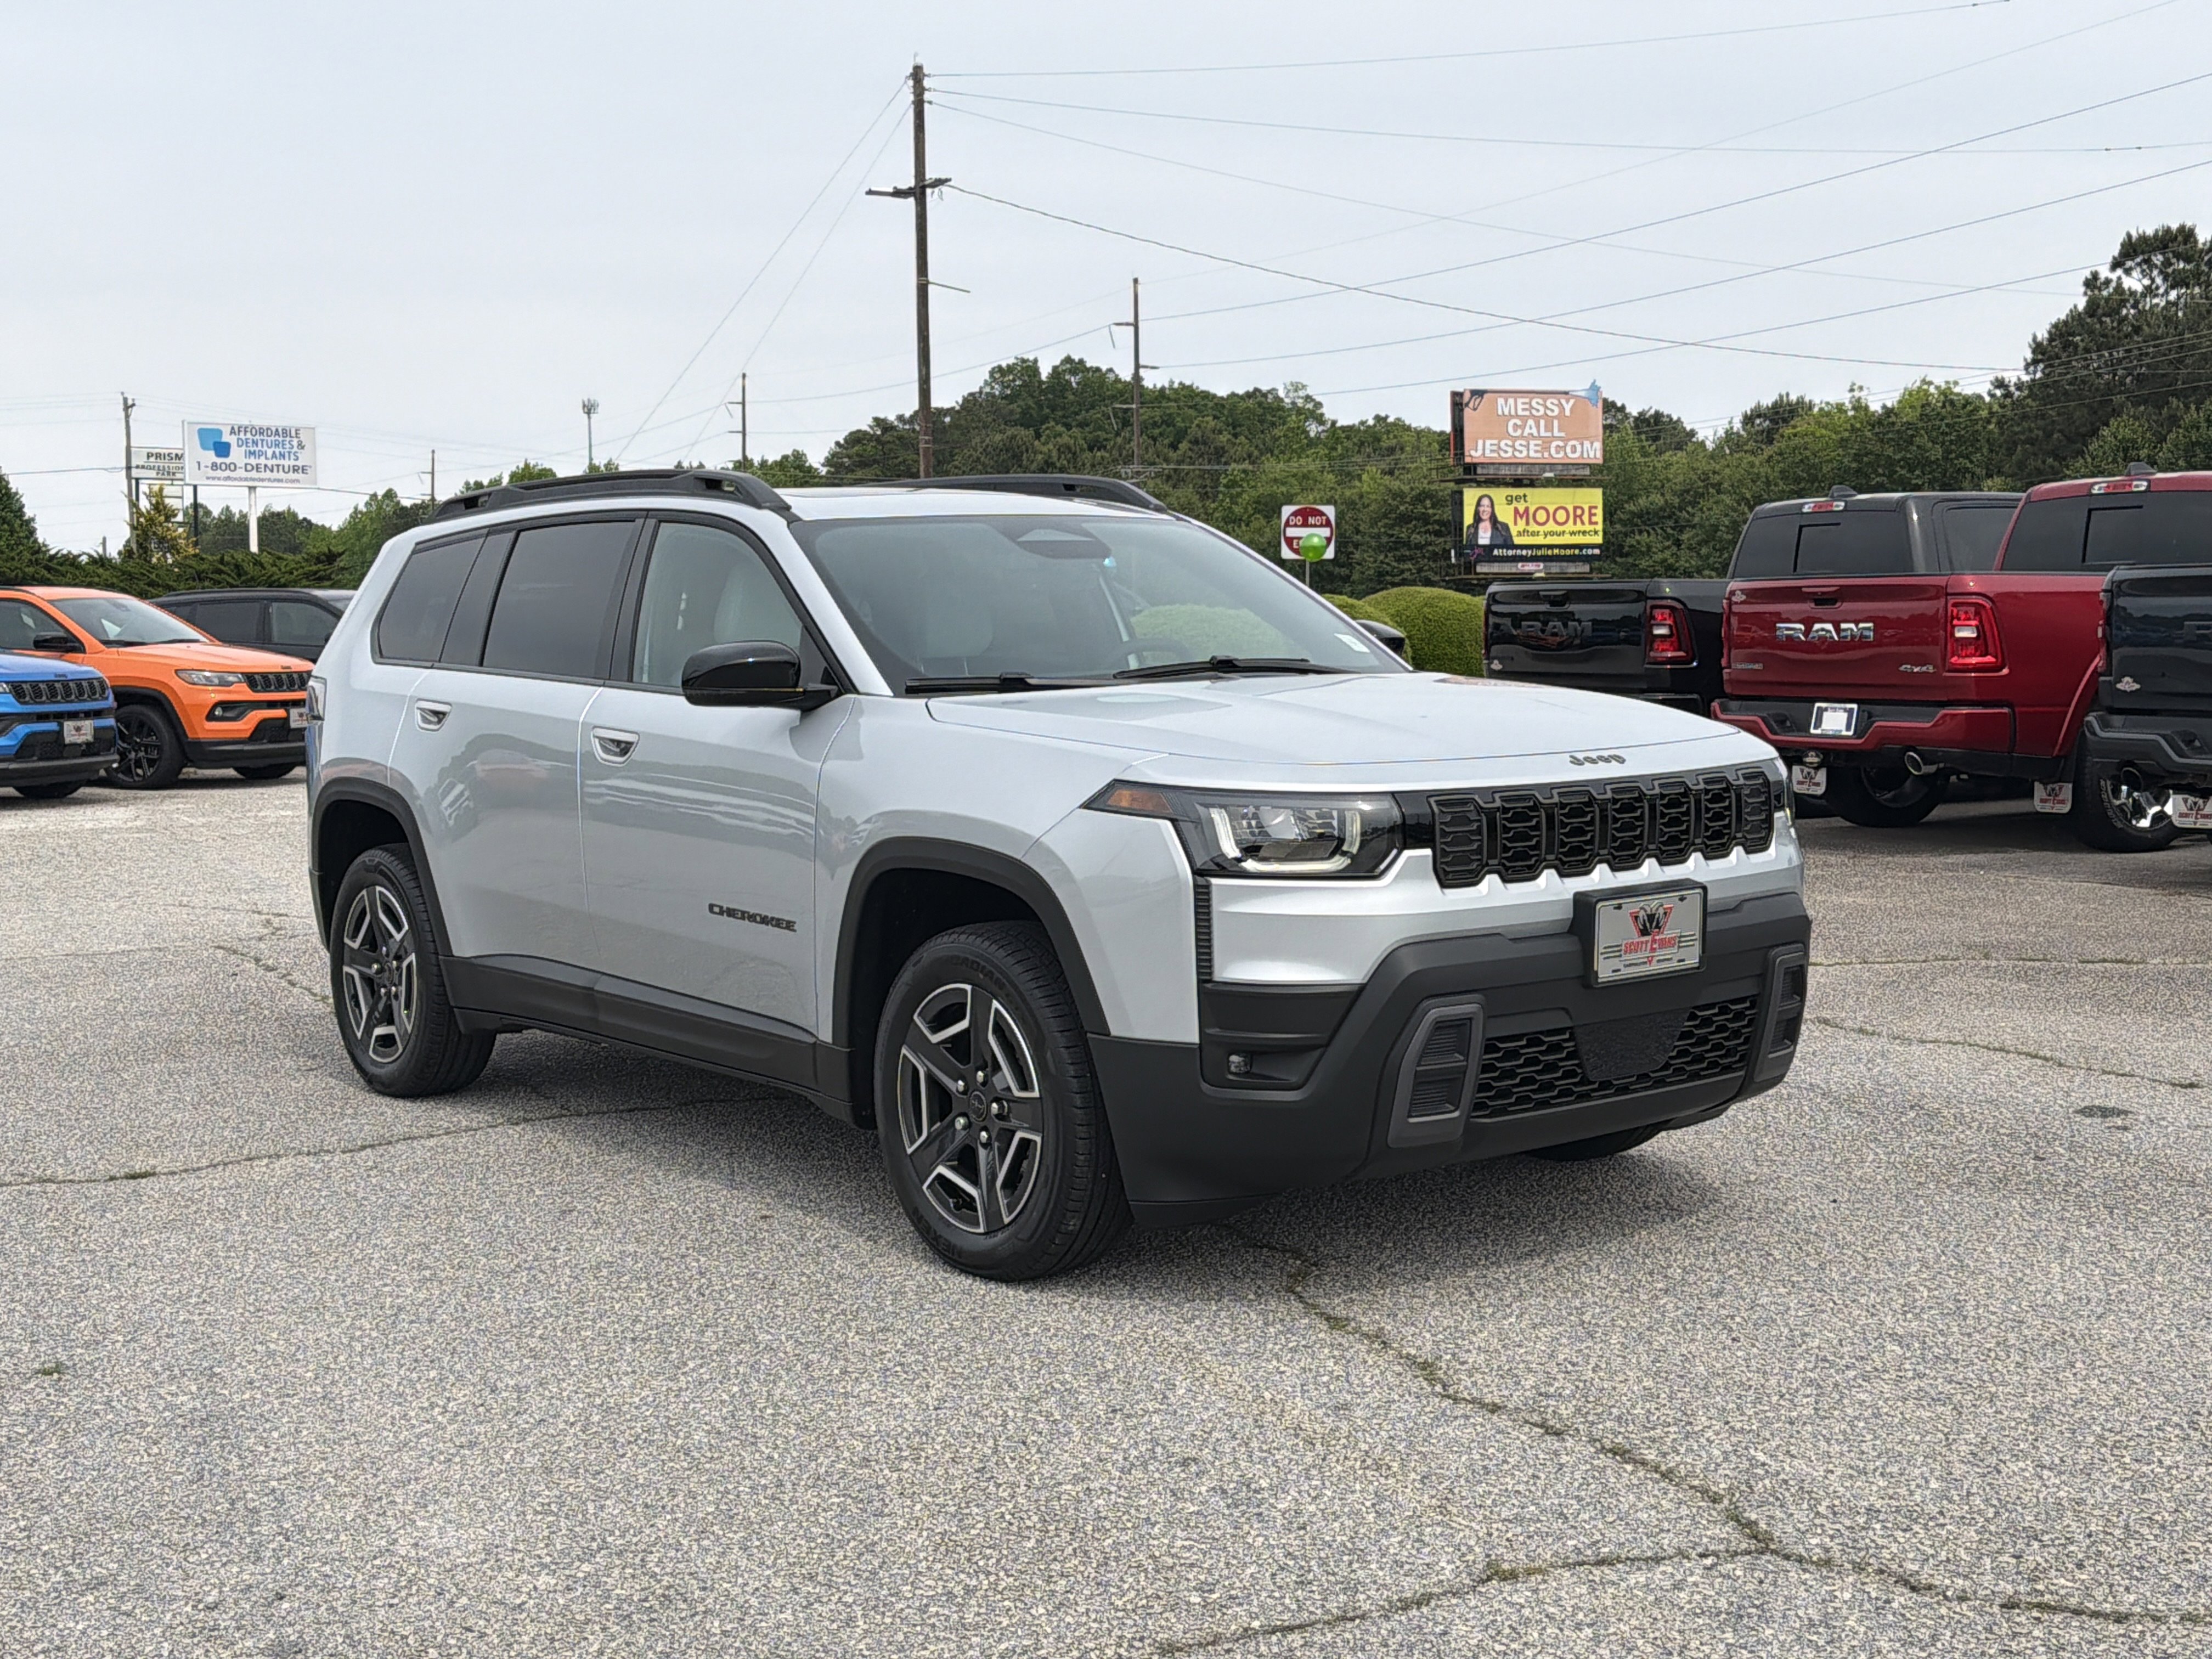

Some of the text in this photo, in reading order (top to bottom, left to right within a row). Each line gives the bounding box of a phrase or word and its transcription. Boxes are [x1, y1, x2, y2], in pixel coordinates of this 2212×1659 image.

[1496, 397, 1576, 417] MESSY
[229, 426, 301, 438] AFFORDABLE
[1506, 419, 1566, 438] CALL
[236, 438, 306, 450] DENTURES &
[1470, 439, 1601, 459] JESSE.COM
[244, 449, 300, 461] IMPLANTS
[196, 461, 309, 475] 1-800-DENTURE
[206, 476, 300, 484] www.affordabledentures.com
[1505, 493, 1528, 505] get
[1289, 516, 1327, 525] DO NOT
[1513, 505, 1599, 526] MOORE
[1516, 528, 1599, 540] after your wreck
[1492, 548, 1601, 557] AttorneyJulieMoore.com
[1521, 621, 1592, 637] RAM
[1775, 623, 1874, 641] RAM
[1568, 754, 1626, 766] Jeep
[708, 902, 797, 933] CHEROKEE
